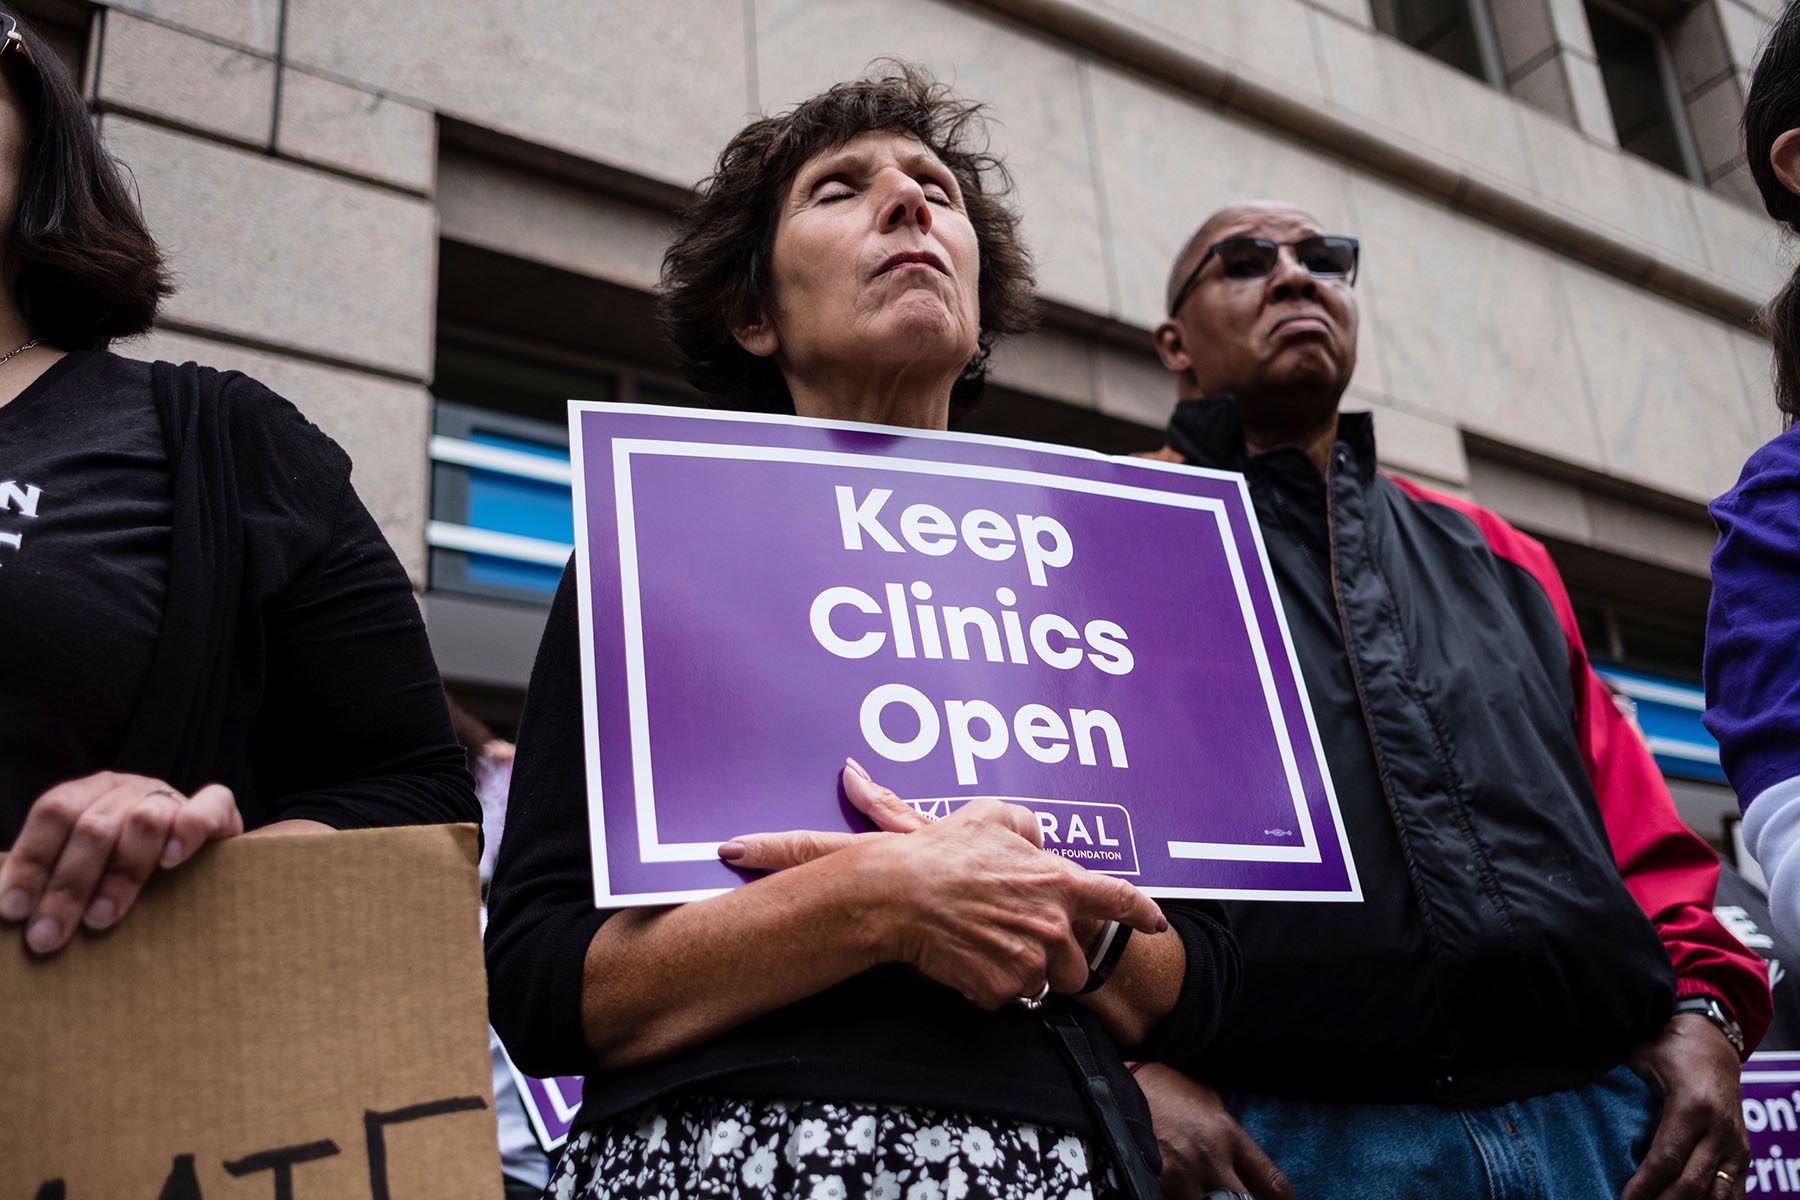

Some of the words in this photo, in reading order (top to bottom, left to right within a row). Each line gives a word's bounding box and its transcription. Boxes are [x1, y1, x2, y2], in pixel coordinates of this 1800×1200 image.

[834, 485, 1074, 587] Keep
[809, 580, 1135, 676] Clinics
[859, 683, 1129, 785] Open
[1034, 811, 1120, 846] RAL
[1061, 848, 1122, 861] FOUNDATION
[1742, 1090, 1800, 1133] on'
